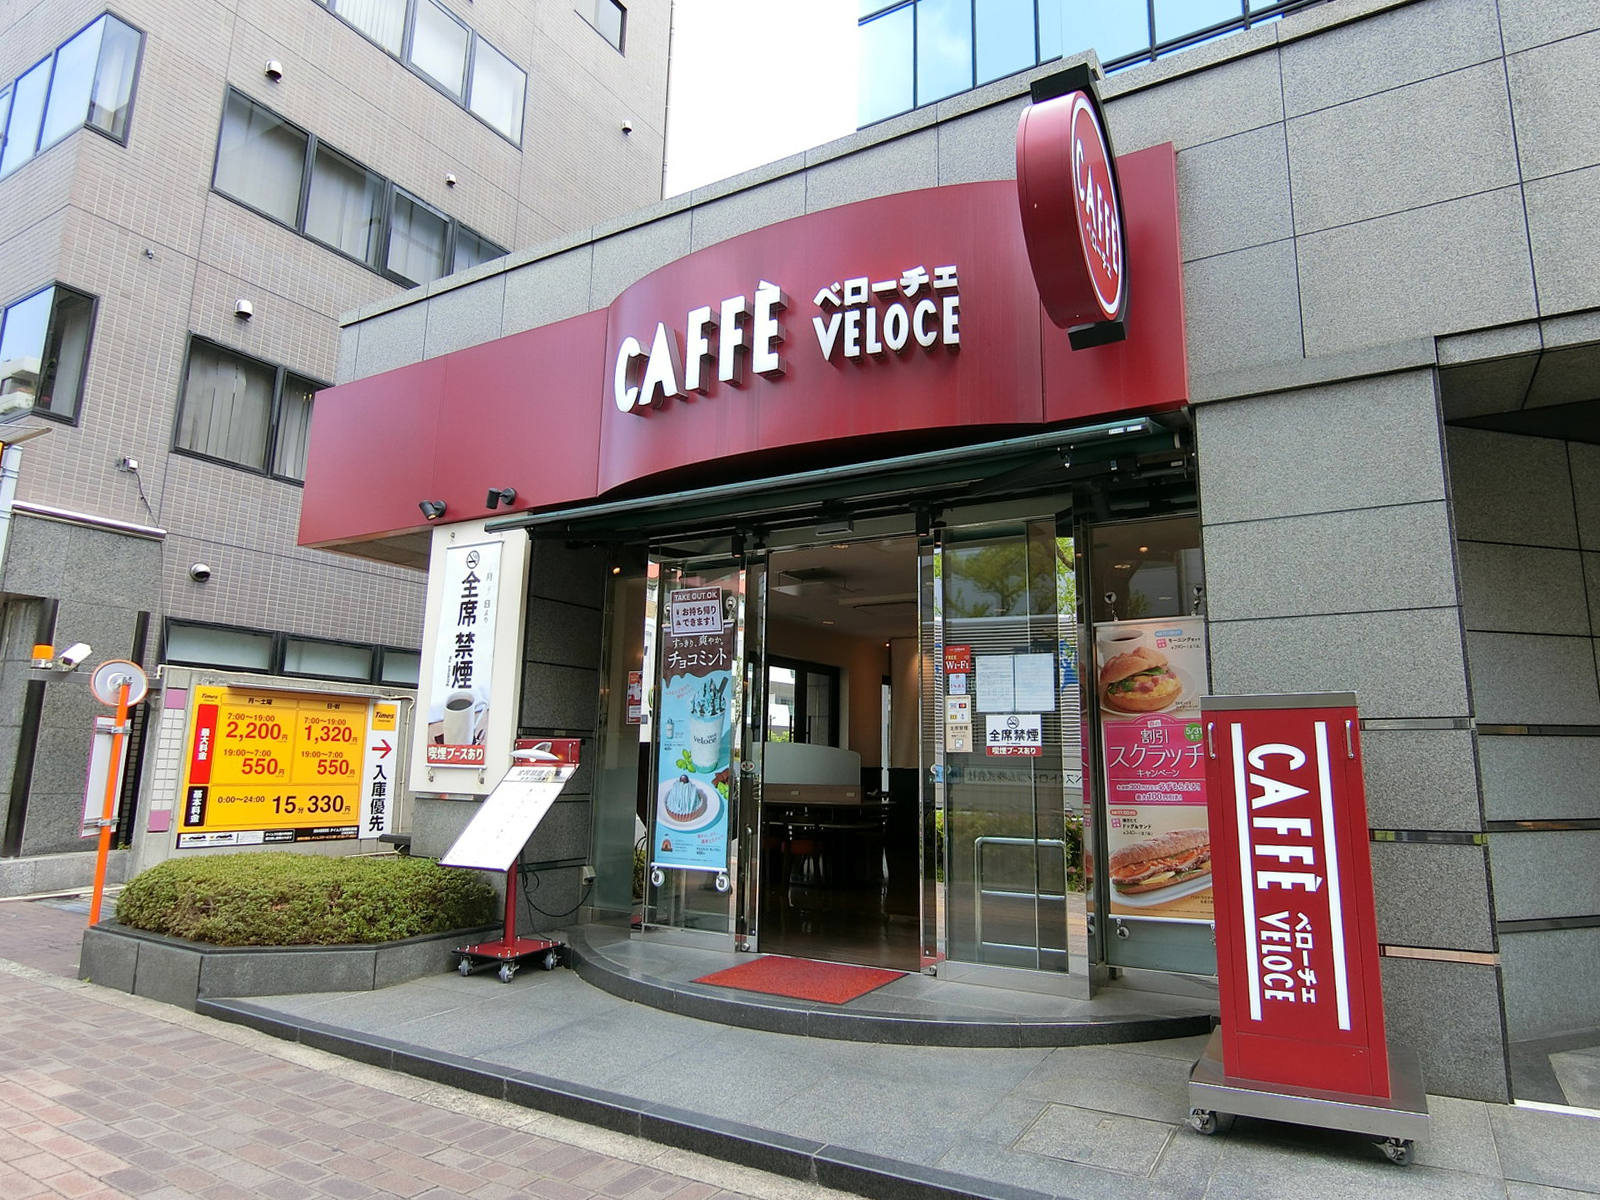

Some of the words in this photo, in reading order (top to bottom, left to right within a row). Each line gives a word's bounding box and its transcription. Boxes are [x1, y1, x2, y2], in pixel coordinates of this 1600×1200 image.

[812, 296, 960, 361] VELOCE
[674, 593, 691, 601] TAKE
[692, 592, 705, 600] OUT
[706, 591, 718, 599] OK
[682, 605, 717, 616] お持ち帰り
[683, 616, 715, 627] できます!
[452, 570, 481, 689] 全席禁煙
[668, 647, 727, 669] チョコミント
[375, 711, 394, 720] Times
[989, 729, 1039, 742] 全席禁煙
[1141, 729, 1169, 744] 割引
[428, 746, 484, 761] 喫煙ブースあり
[991, 746, 1037, 755] 喫煙ブースあり
[1110, 743, 1204, 768] スクラッチ
[1137, 769, 1180, 777] キャンペーン
[368, 764, 387, 832] 入庫優先
[1259, 911, 1295, 1002] VELOCE
